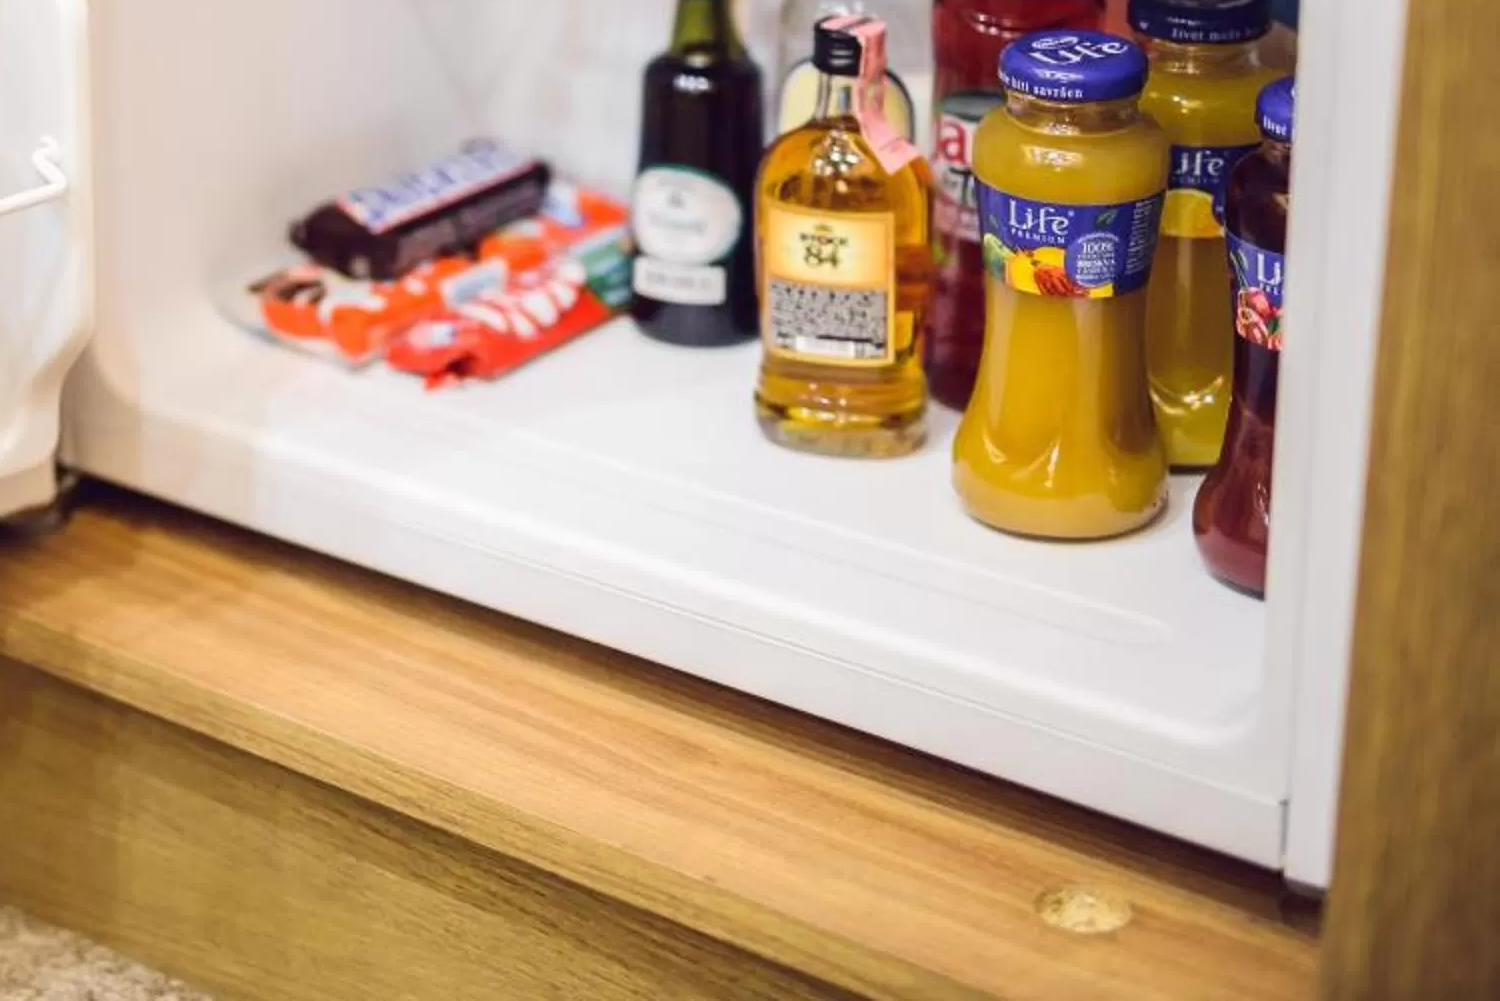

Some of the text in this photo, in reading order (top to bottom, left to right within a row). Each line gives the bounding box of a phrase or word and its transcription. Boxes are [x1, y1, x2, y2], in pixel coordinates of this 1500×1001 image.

[1028, 41, 1130, 66] Life
[1172, 150, 1225, 177] ife
[1008, 198, 1070, 236] Life
[1010, 227, 1066, 245] PREMIUM
[1257, 253, 1281, 285] Li
